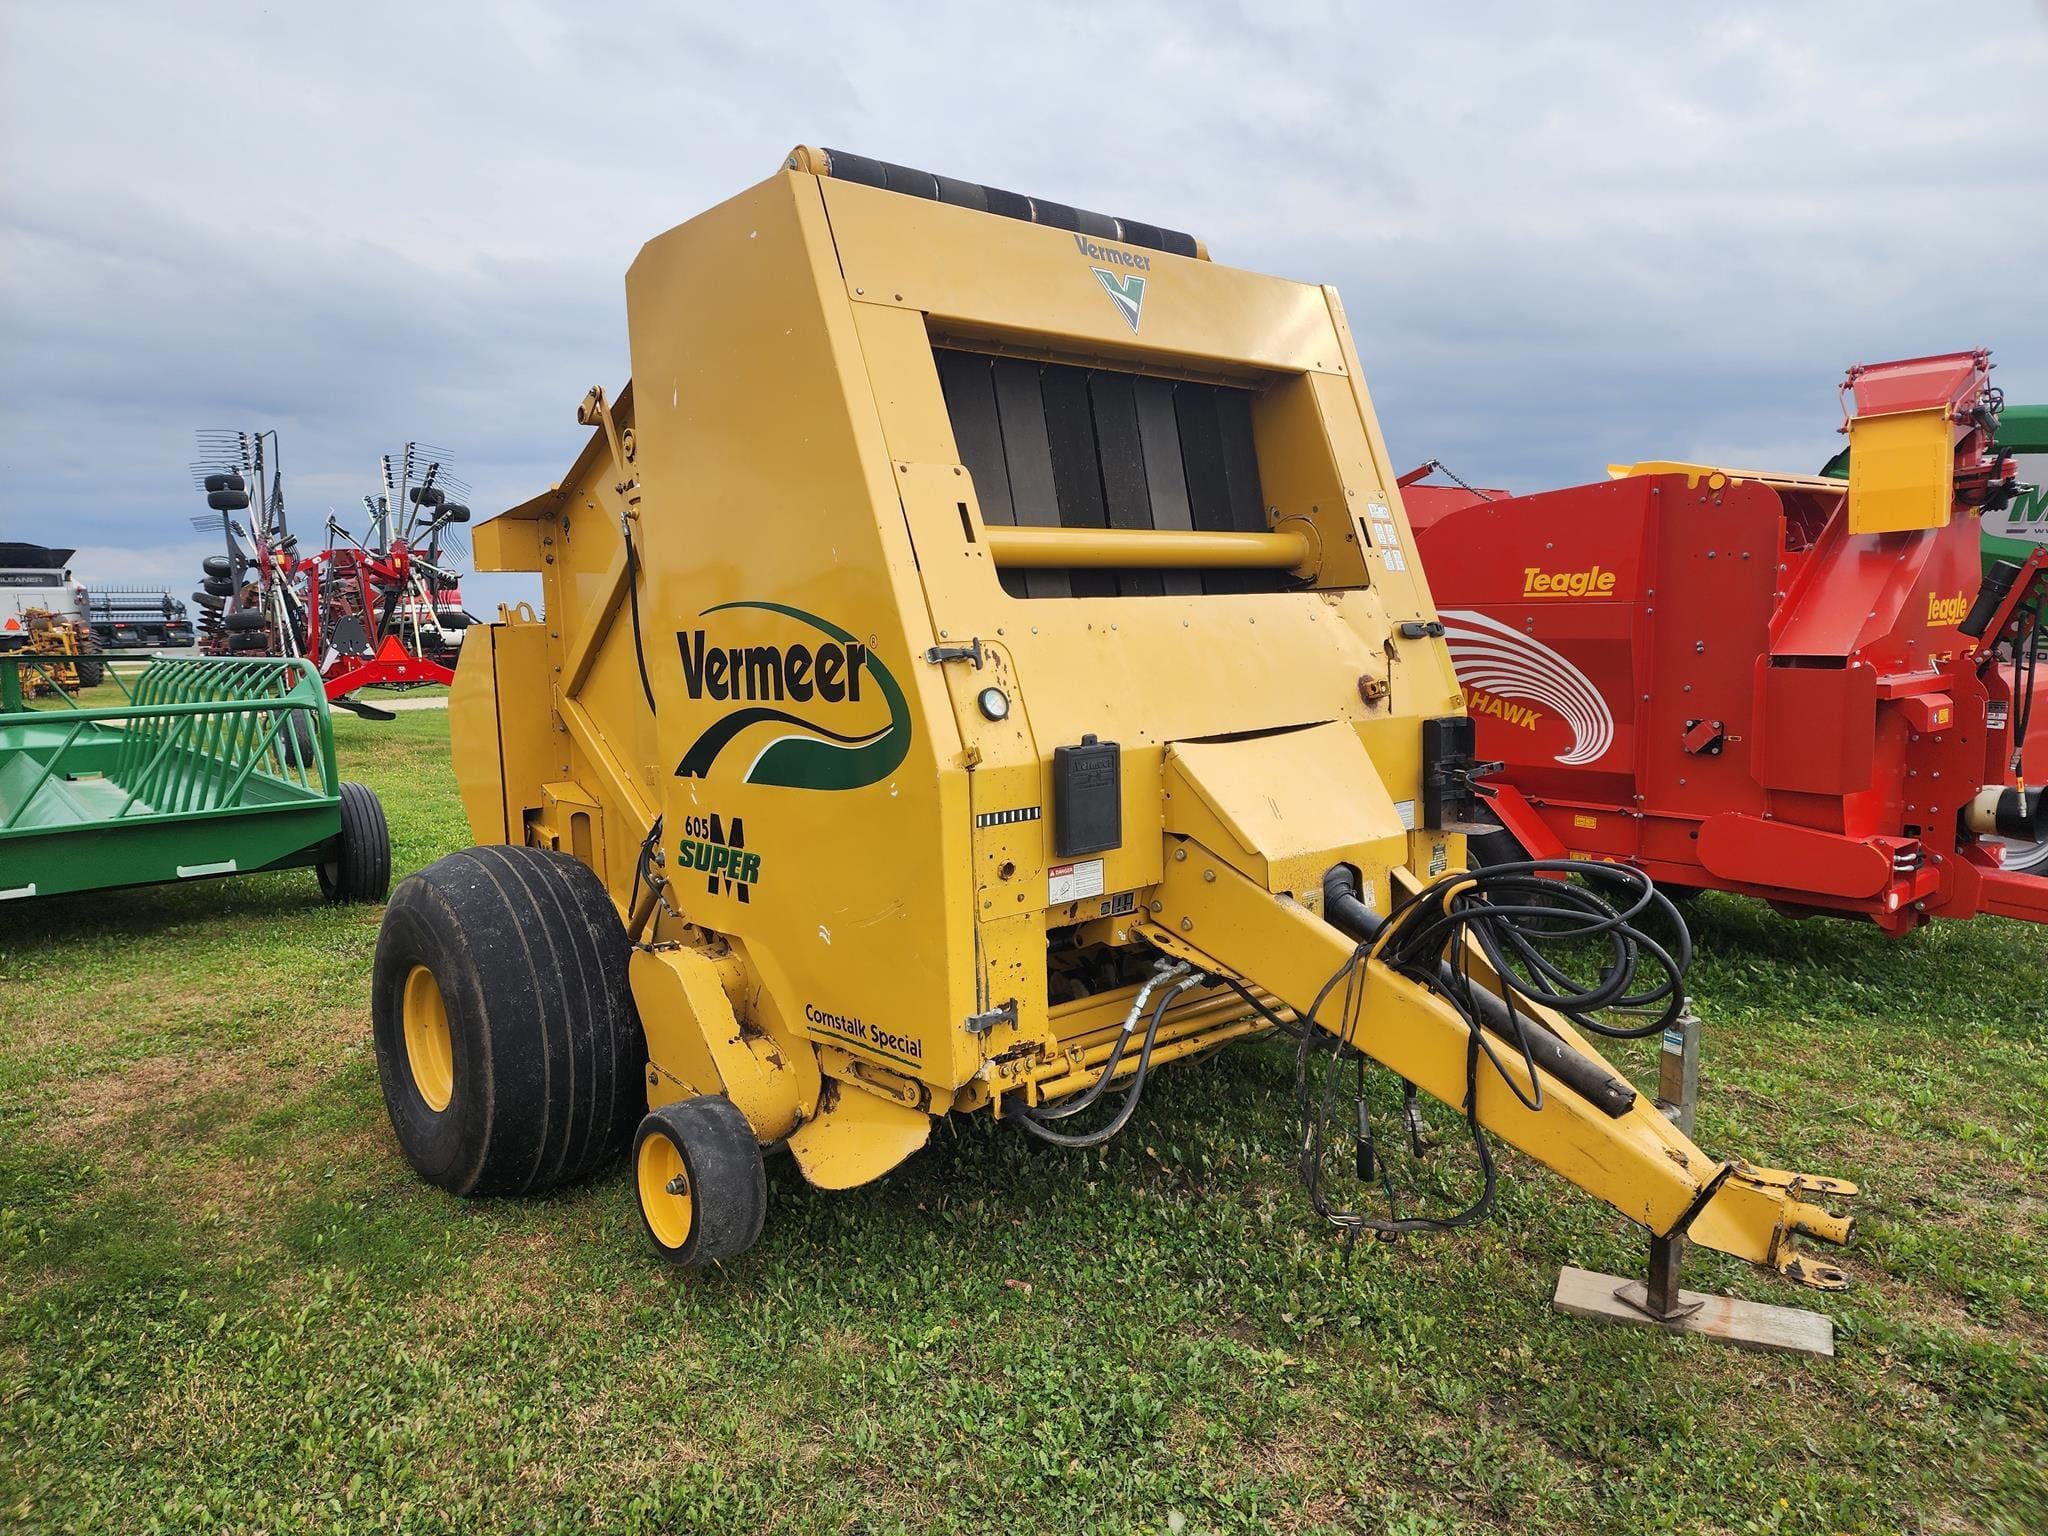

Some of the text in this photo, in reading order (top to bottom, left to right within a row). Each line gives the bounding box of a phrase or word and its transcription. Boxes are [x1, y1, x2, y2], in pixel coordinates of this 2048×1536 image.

[1073, 233, 1151, 272] Vermeer
[1524, 565, 1617, 597] Teagle
[1928, 590, 1968, 625] Teagle
[676, 630, 866, 703] Vermeer
[685, 815, 709, 840] 605
[678, 839, 761, 885] SUPER
[805, 1003, 922, 1058] Cornstalk Special
